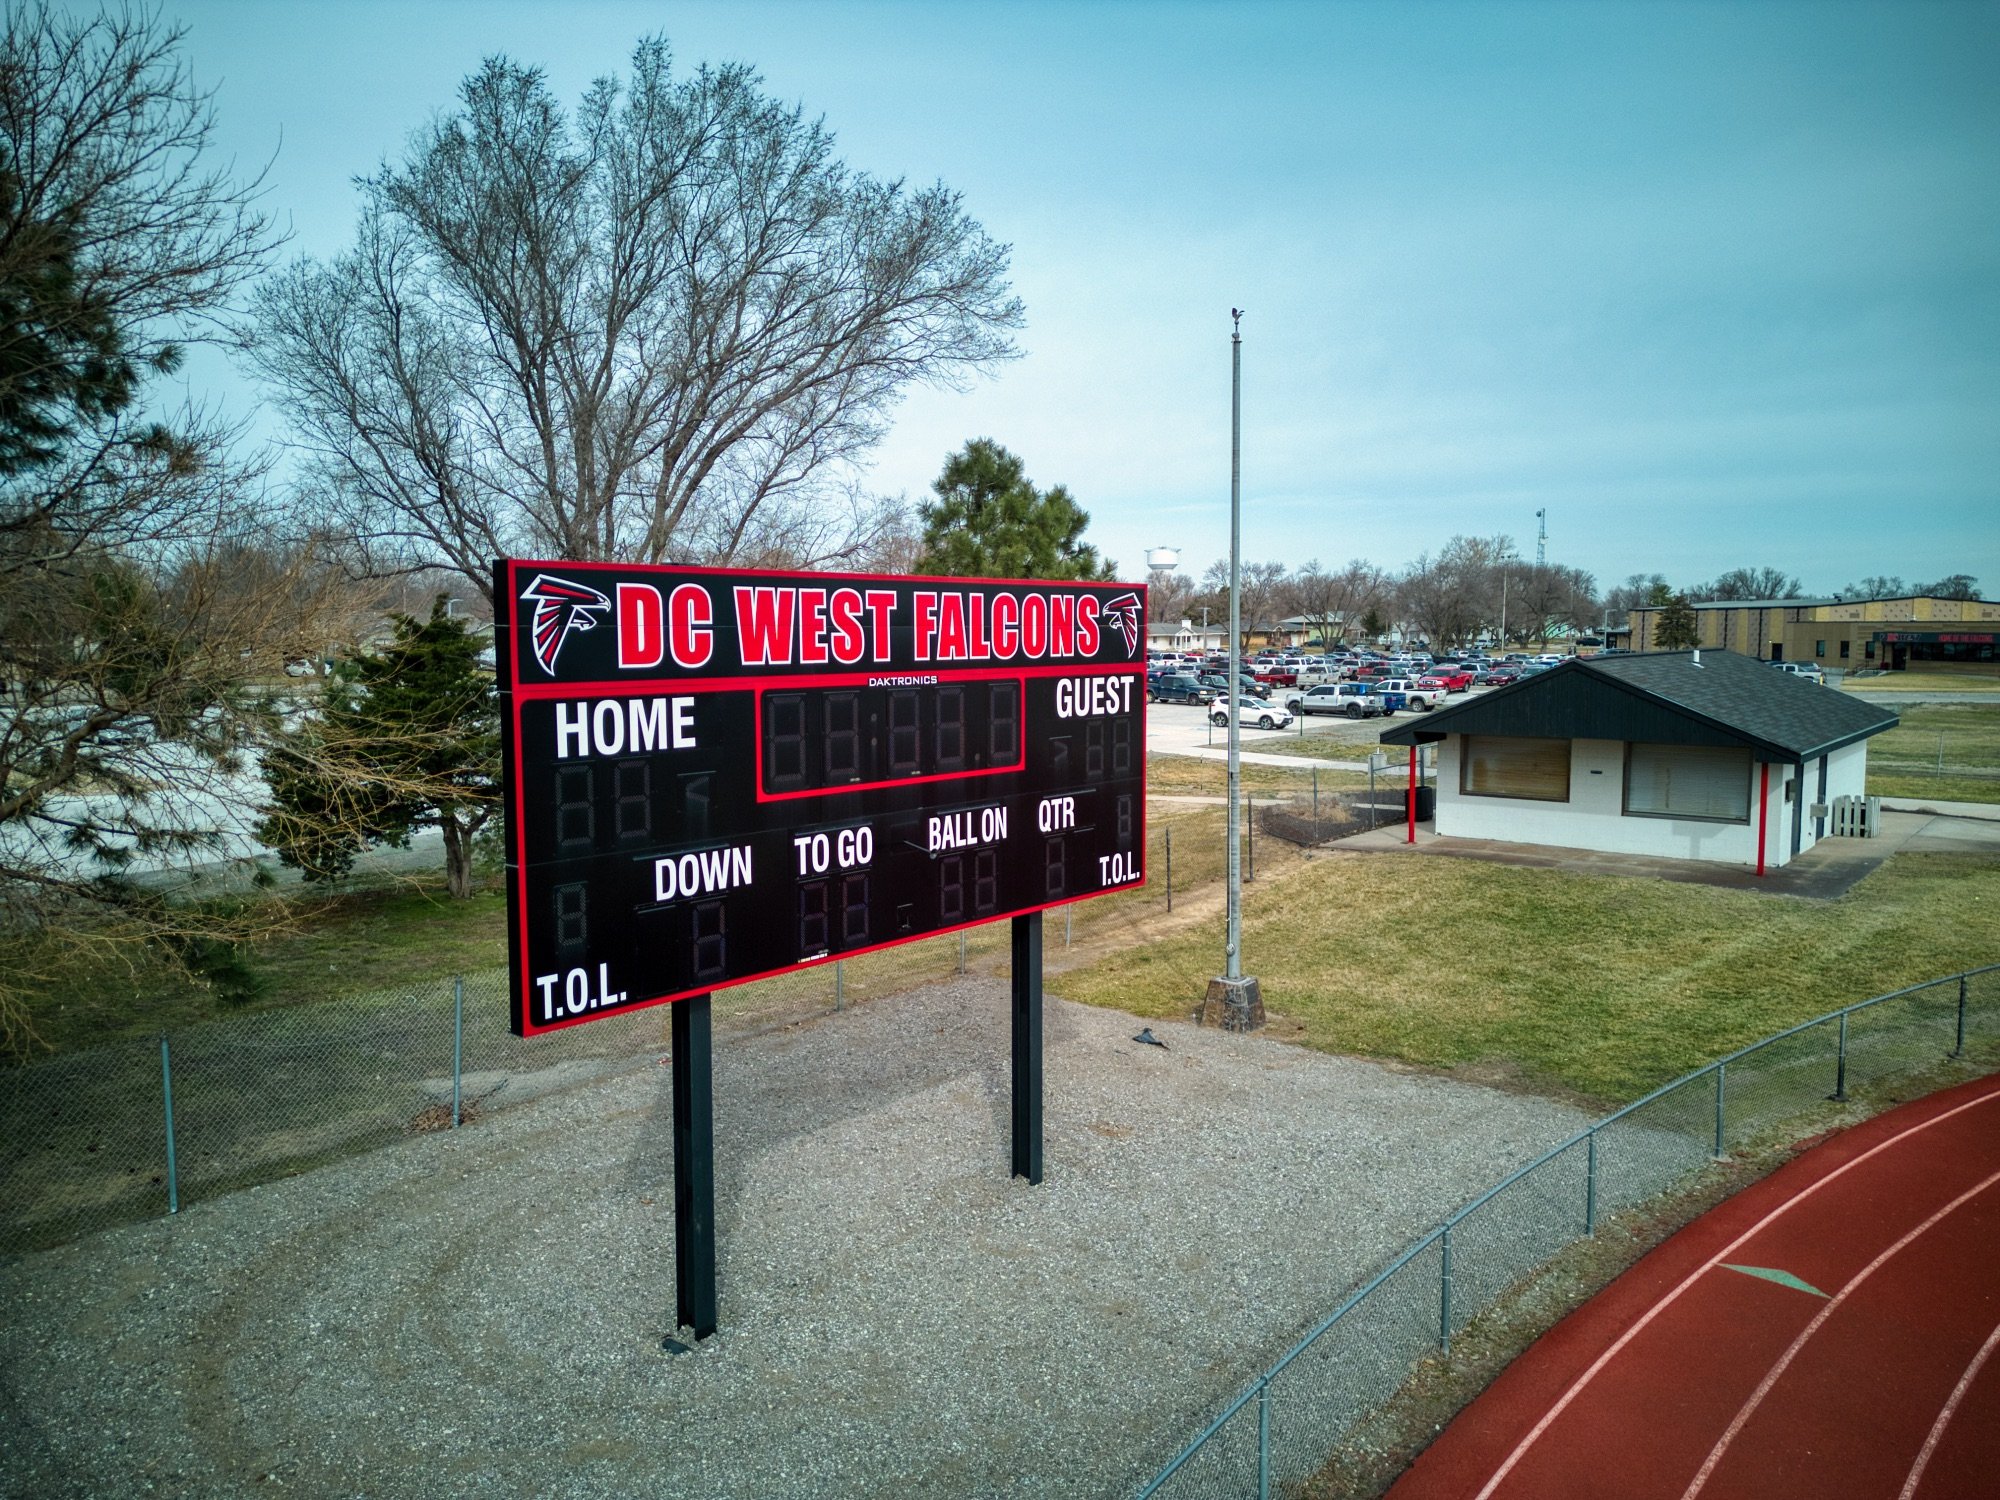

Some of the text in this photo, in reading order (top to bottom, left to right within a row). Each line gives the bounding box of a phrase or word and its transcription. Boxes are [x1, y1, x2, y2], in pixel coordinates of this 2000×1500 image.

[616, 582, 1100, 668] DC WEST FALCONS
[868, 675, 938, 687] DAKTRONICS
[1056, 676, 1135, 718] GUEST
[556, 697, 696, 758] HOME
[929, 806, 1008, 851] BALL ON
[1038, 796, 1075, 833] QTR
[655, 846, 752, 901] DOWN
[794, 827, 873, 875] TO GO
[1099, 851, 1140, 886] T.O.L.
[536, 963, 627, 1020] T.O.L.
